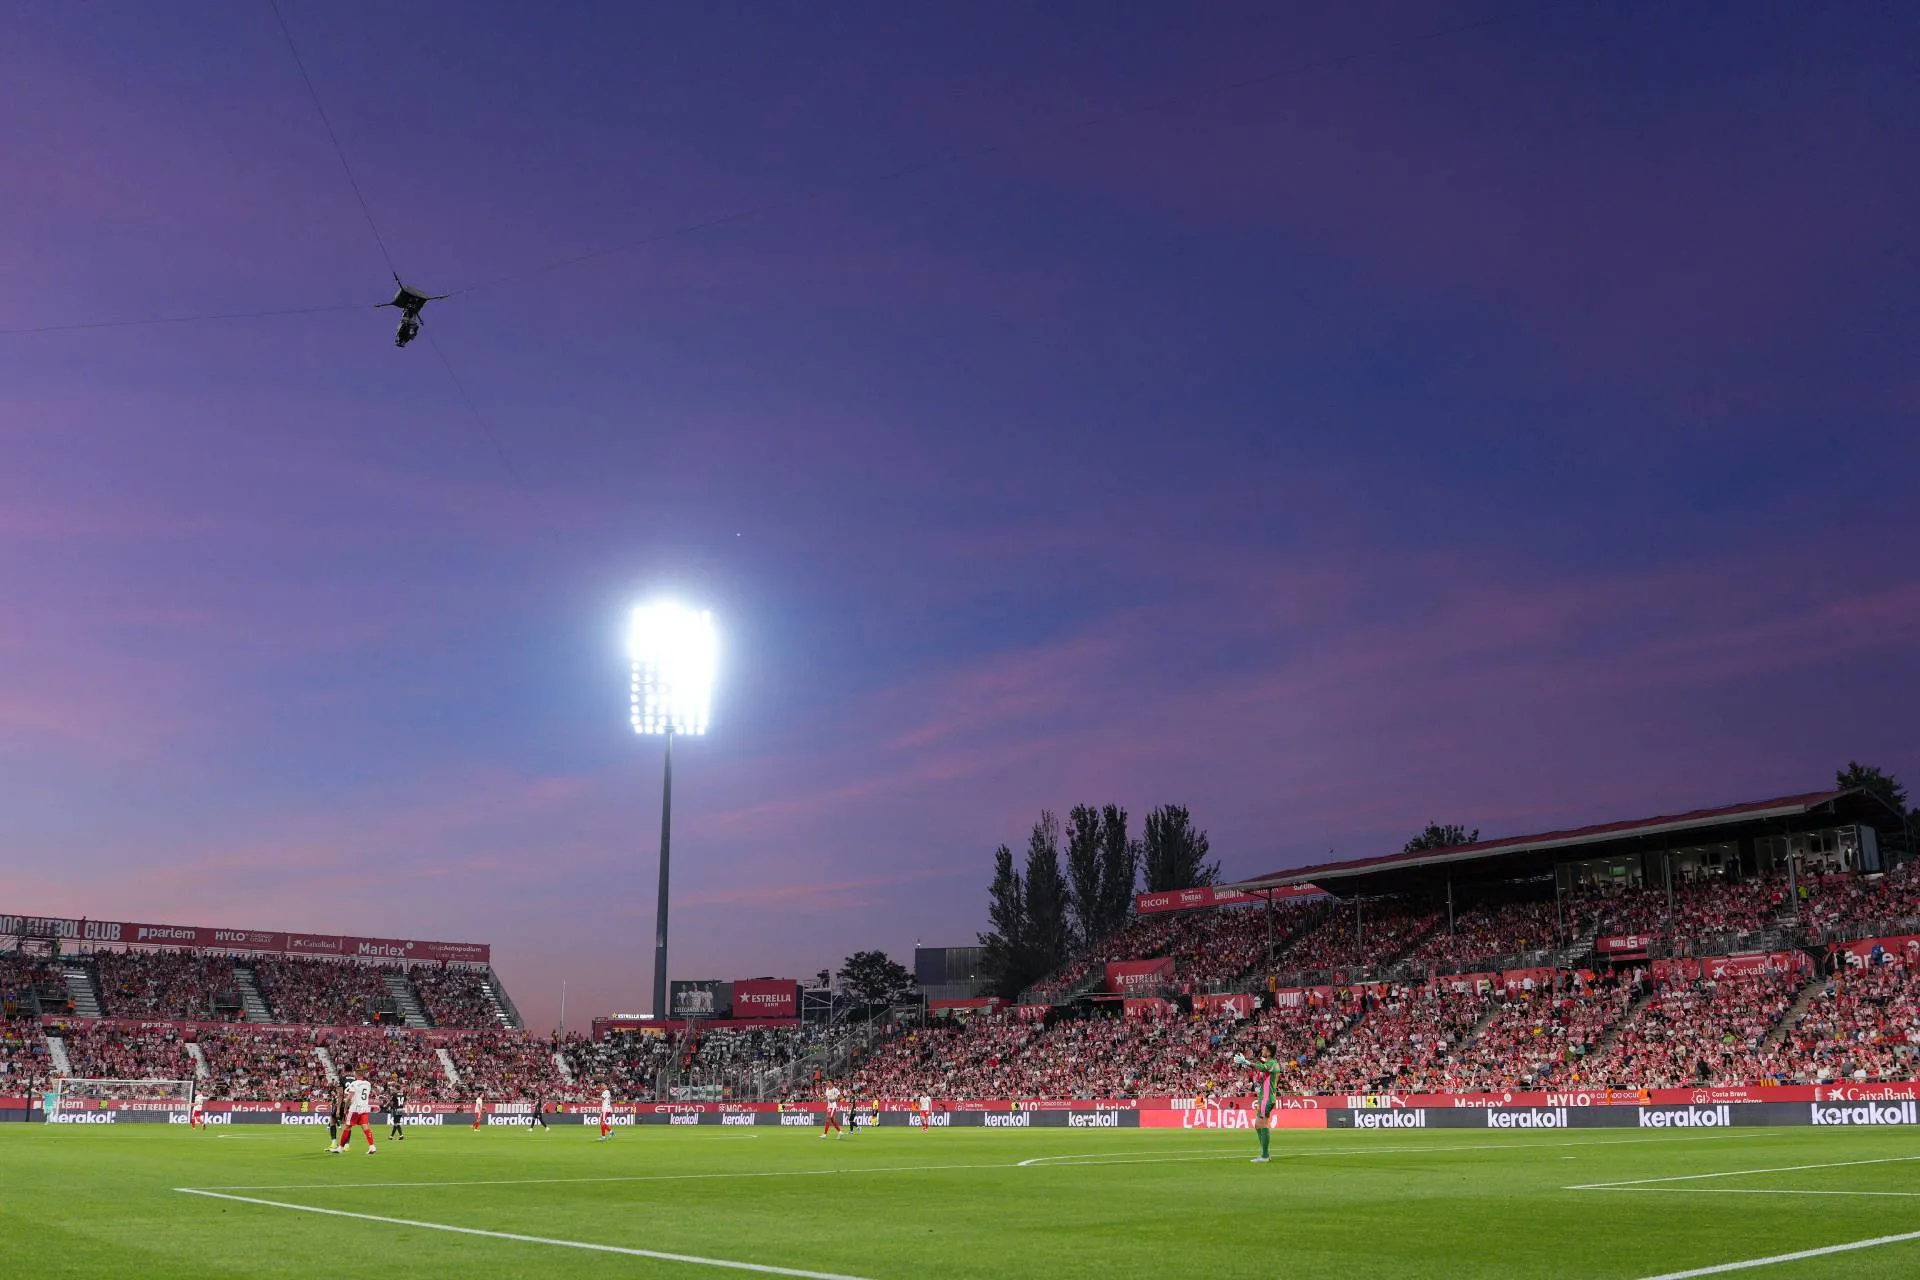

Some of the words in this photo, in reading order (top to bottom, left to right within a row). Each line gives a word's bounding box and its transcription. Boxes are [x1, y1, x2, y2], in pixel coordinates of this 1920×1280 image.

[1140, 898, 1169, 908] RICOH
[84, 921, 121, 941] CLUB
[149, 927, 196, 940] parlem
[358, 942, 405, 957] Marlex
[751, 993, 791, 1004] ESTRELLA
[361, 1088, 367, 1101] 5
[1847, 1087, 1916, 1101] CaixaBank
[655, 1105, 705, 1113] ETIHAD
[1638, 1105, 1730, 1127] kerakoll
[1811, 1101, 1917, 1125] kerakoll
[670, 1113, 699, 1125] kerakoll
[722, 1113, 755, 1126] kerakoll
[984, 1112, 1030, 1127] kerakoll
[1068, 1111, 1118, 1127] kerakoll
[1183, 1109, 1249, 1129] LALIGA
[1354, 1109, 1426, 1128] kerakoll
[1487, 1107, 1568, 1128] kerakoll
